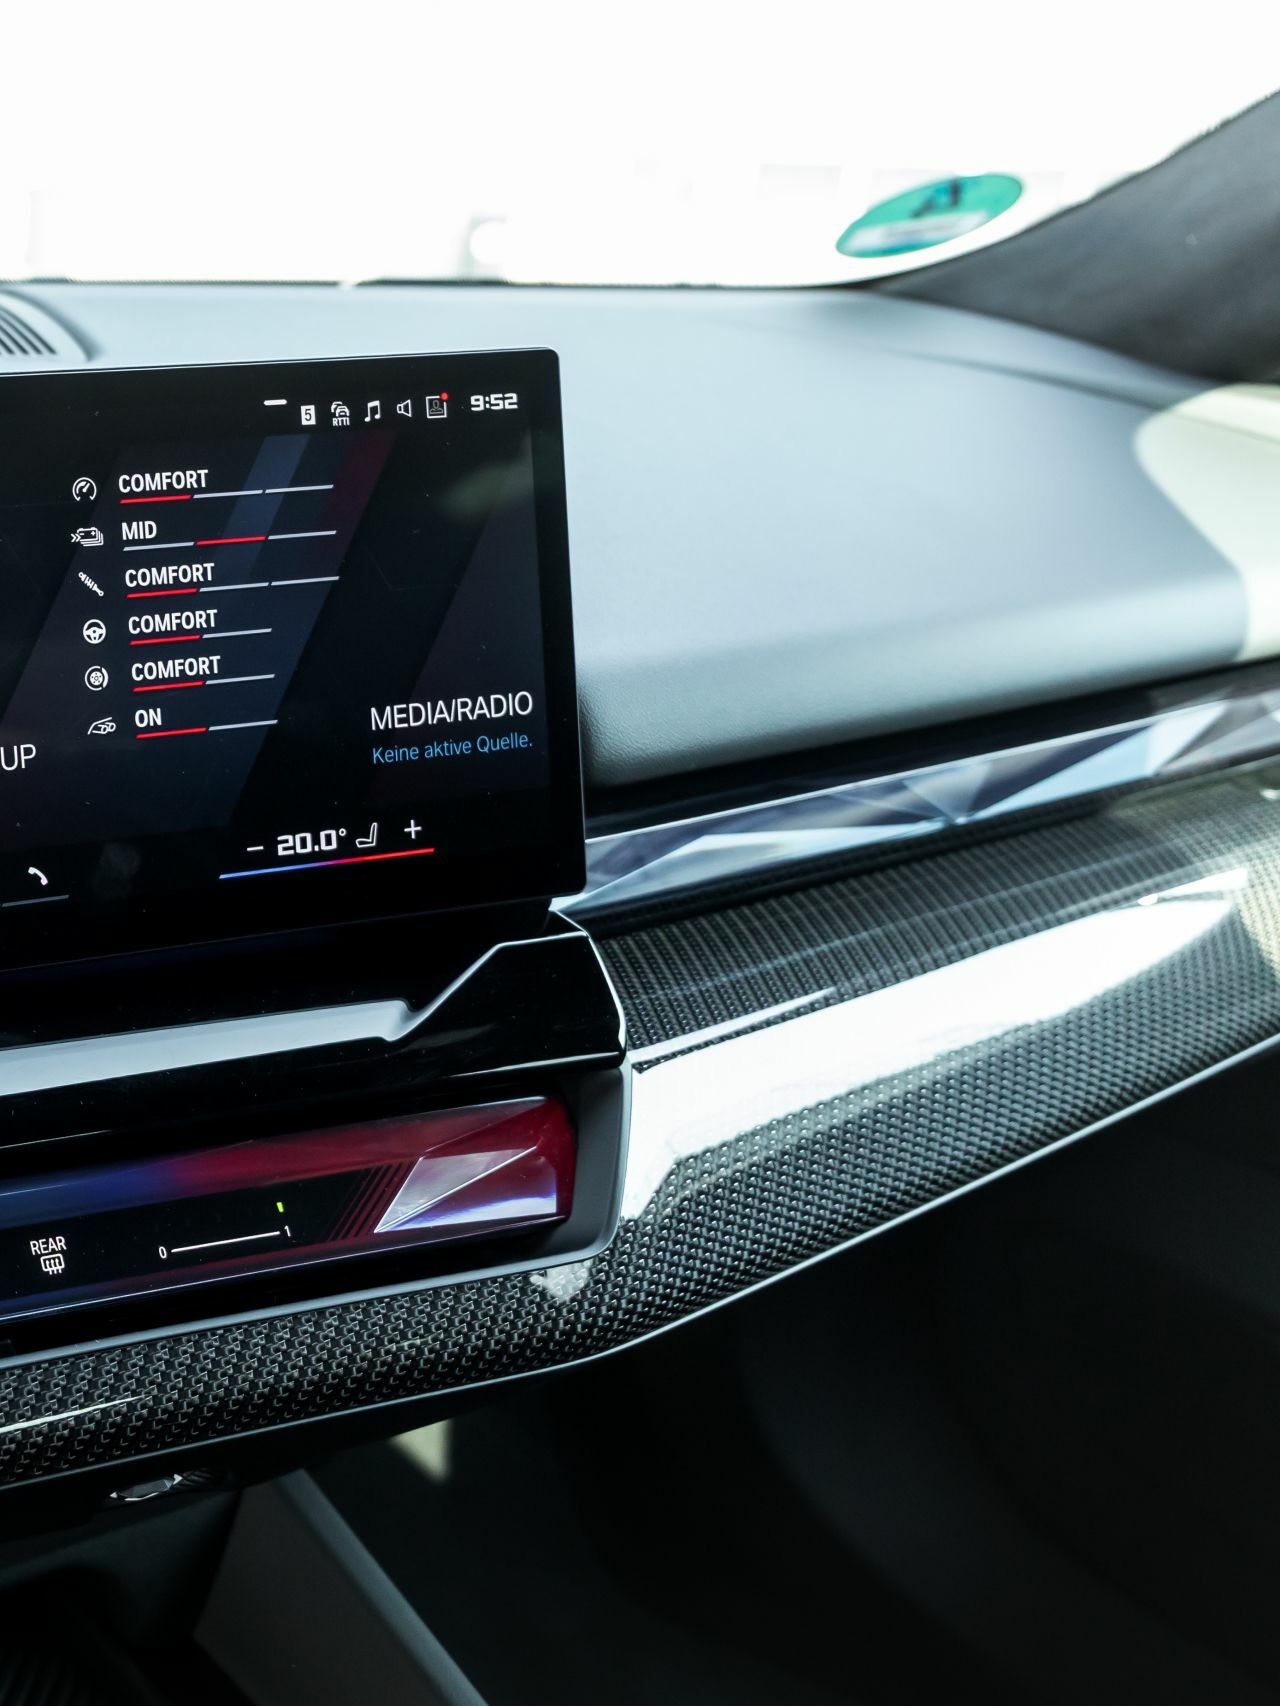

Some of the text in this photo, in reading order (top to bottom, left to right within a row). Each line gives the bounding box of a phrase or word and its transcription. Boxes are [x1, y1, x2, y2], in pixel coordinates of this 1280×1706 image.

[470, 393, 518, 411] 9:52
[118, 470, 209, 494] COMFORT
[122, 521, 157, 541] MID
[125, 563, 215, 588] COMFORT
[128, 610, 218, 635] COMFORT
[131, 656, 221, 681] COMFORT
[134, 708, 162, 728] ON
[370, 690, 532, 731] MEDIA/RADIO
[372, 732, 533, 764] Keine aktive Quelle.
[277, 828, 347, 856] 20.0°
[30, 1236, 67, 1256] REAR
[158, 1246, 167, 1259] 0
